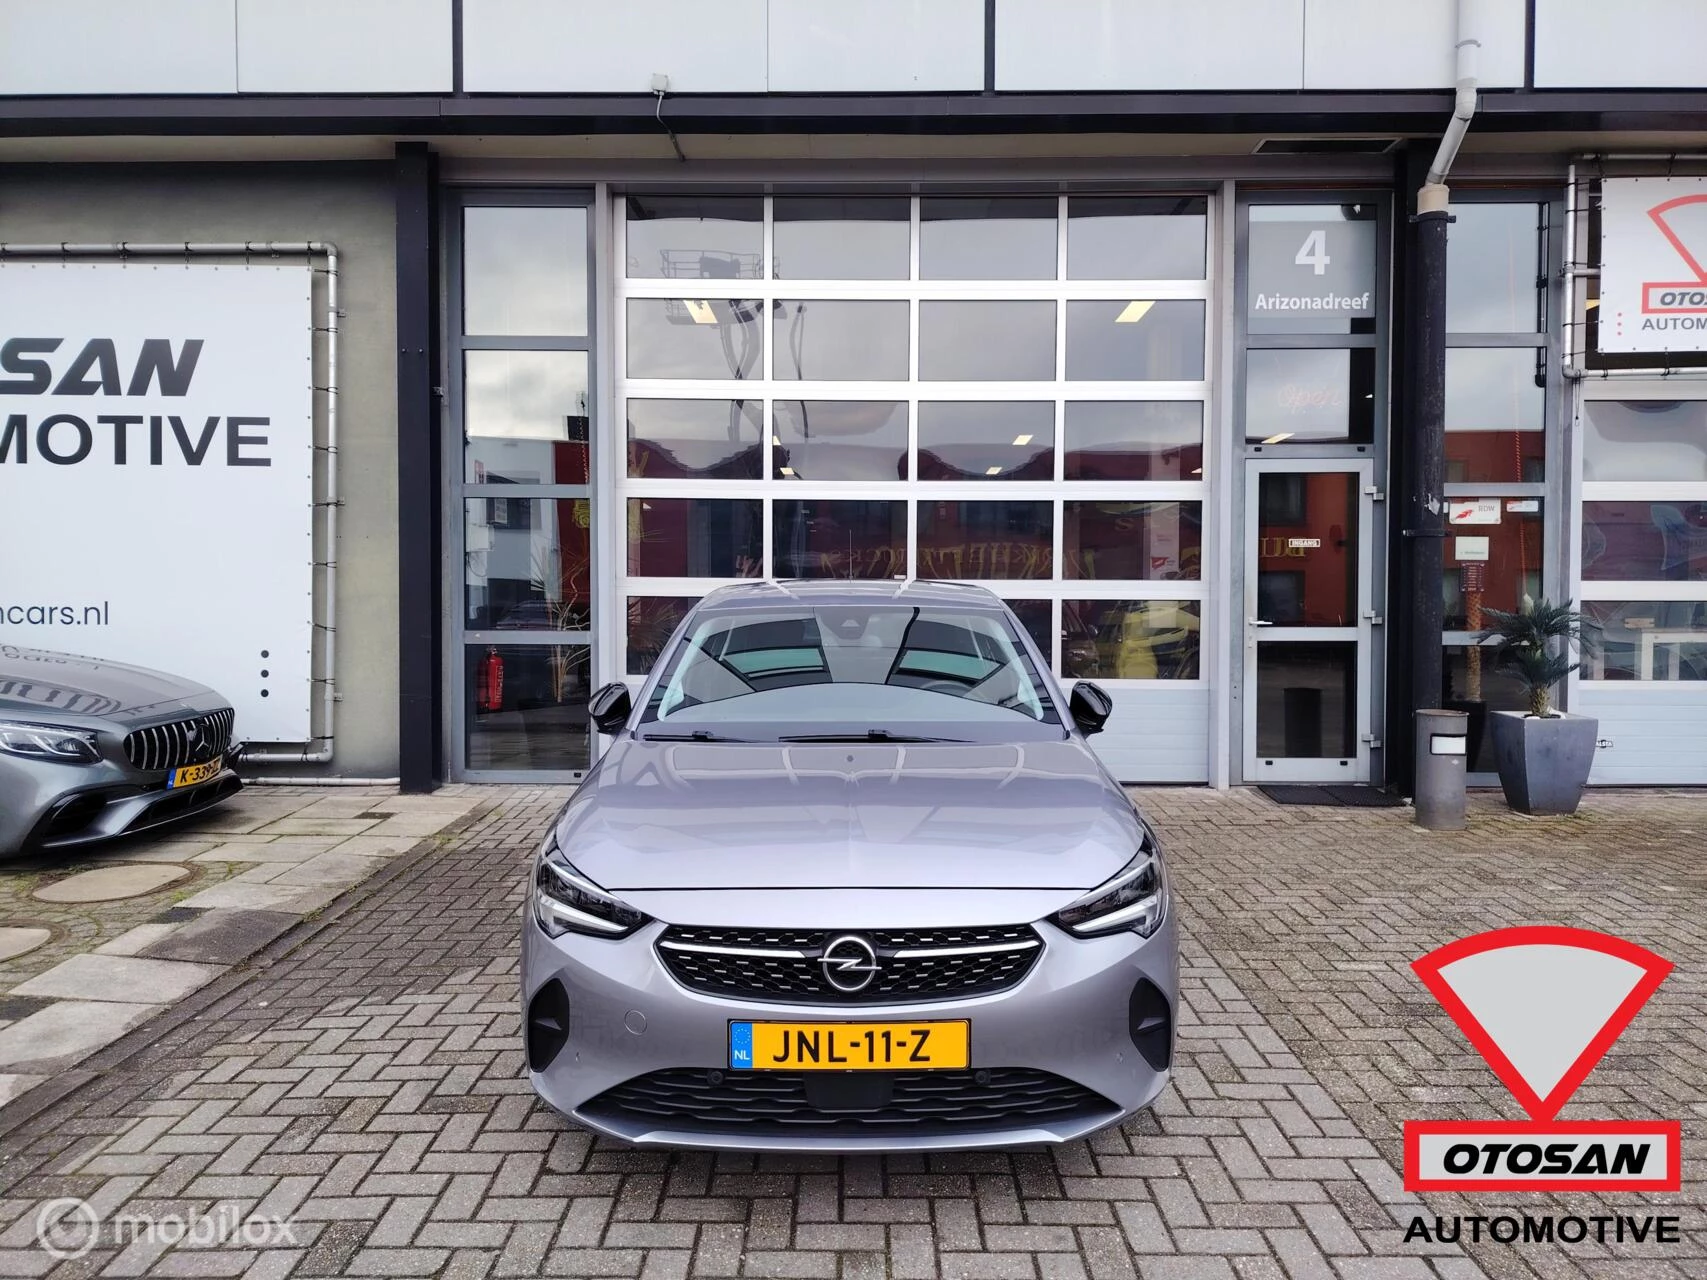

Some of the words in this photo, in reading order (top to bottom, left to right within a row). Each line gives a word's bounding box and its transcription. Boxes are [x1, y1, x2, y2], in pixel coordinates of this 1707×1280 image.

[1295, 230, 1331, 275] 4
[1255, 292, 1370, 310] Arizonadreef
[1660, 291, 1707, 306] OTO
[1641, 317, 1707, 330] AUTOM
[0, 600, 108, 626] cars.nl
[734, 1049, 750, 1061] NL
[773, 1029, 931, 1063] JNL-11-Z
